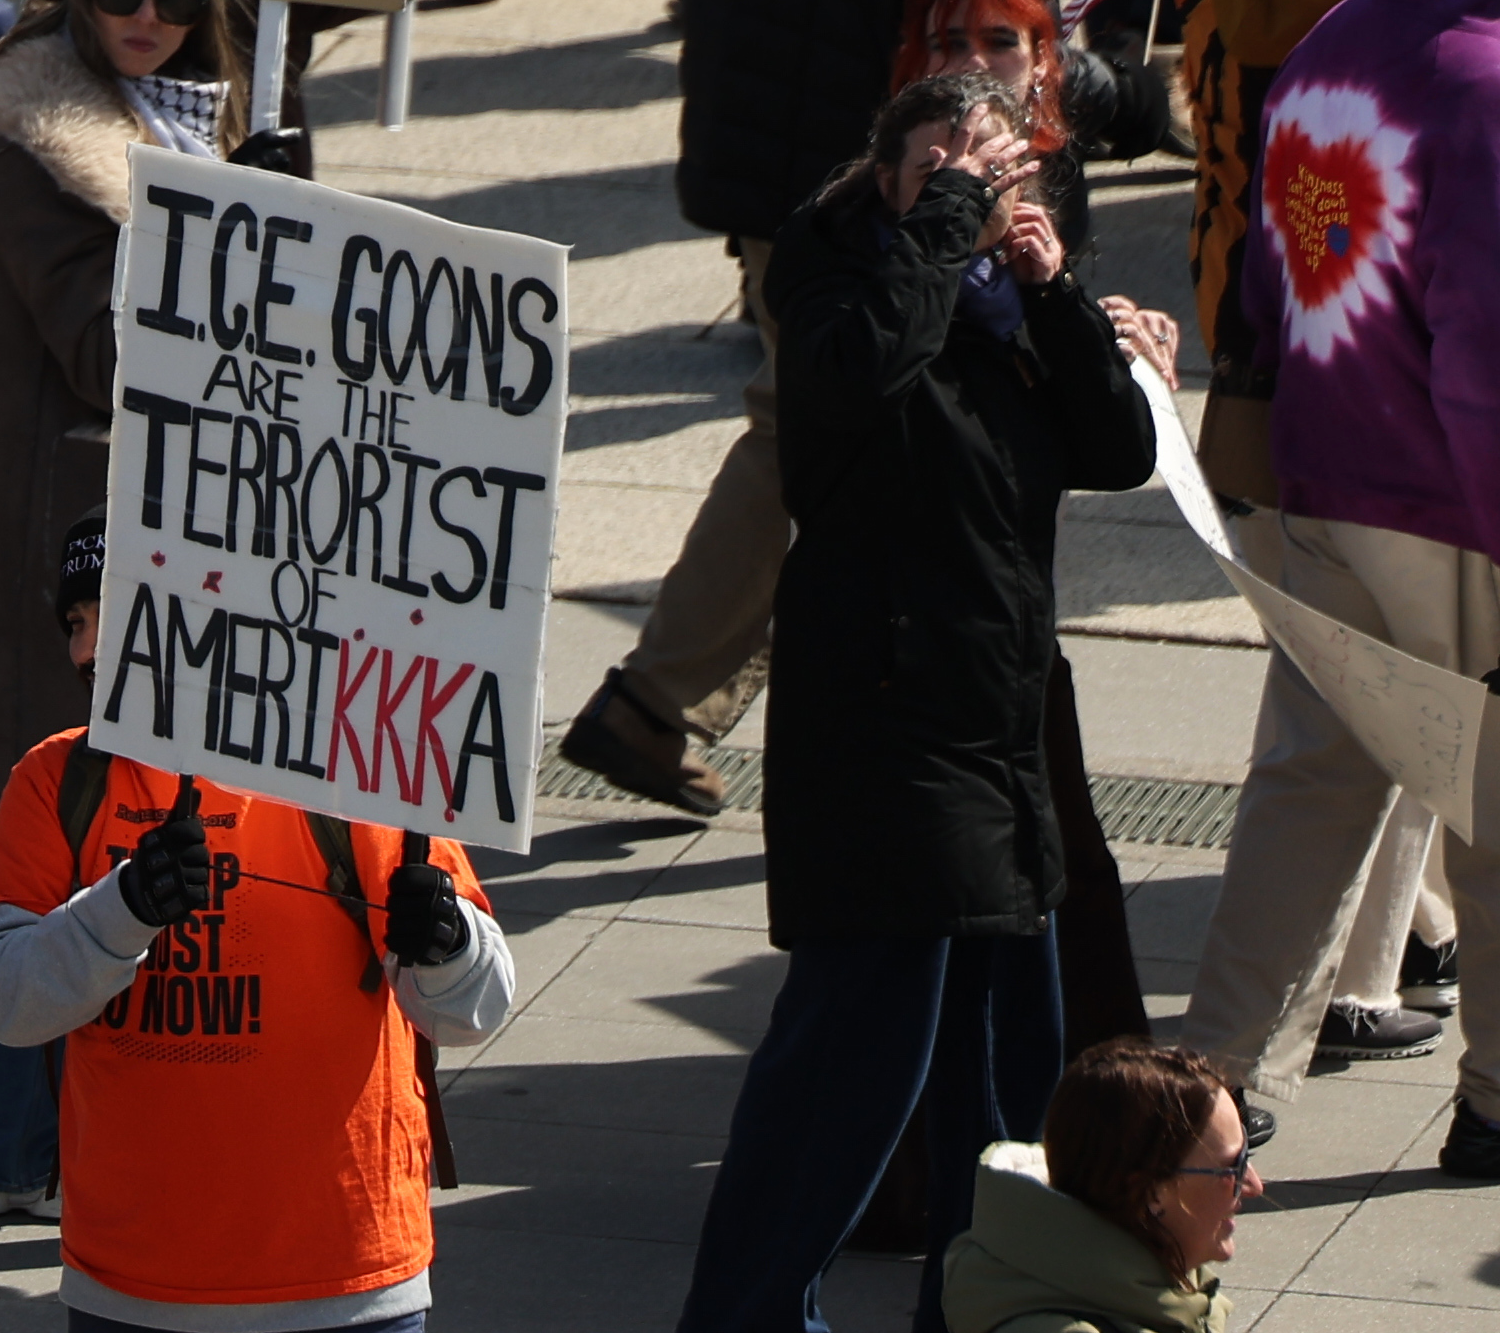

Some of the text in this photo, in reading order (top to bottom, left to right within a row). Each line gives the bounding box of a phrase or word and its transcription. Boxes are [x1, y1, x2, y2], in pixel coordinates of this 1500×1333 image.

[1298, 163, 1345, 197] Kindness
[1316, 196, 1346, 212] down
[1299, 236, 1326, 257] stood
[1306, 255, 1319, 275] up
[136, 183, 559, 416] I.C.E. GOONS
[201, 355, 416, 452] ARE THE
[122, 385, 547, 610] TERRORIST
[271, 558, 339, 629] OF
[103, 581, 517, 824] AMERIKKKA
[139, 974, 262, 1036] NOW!
